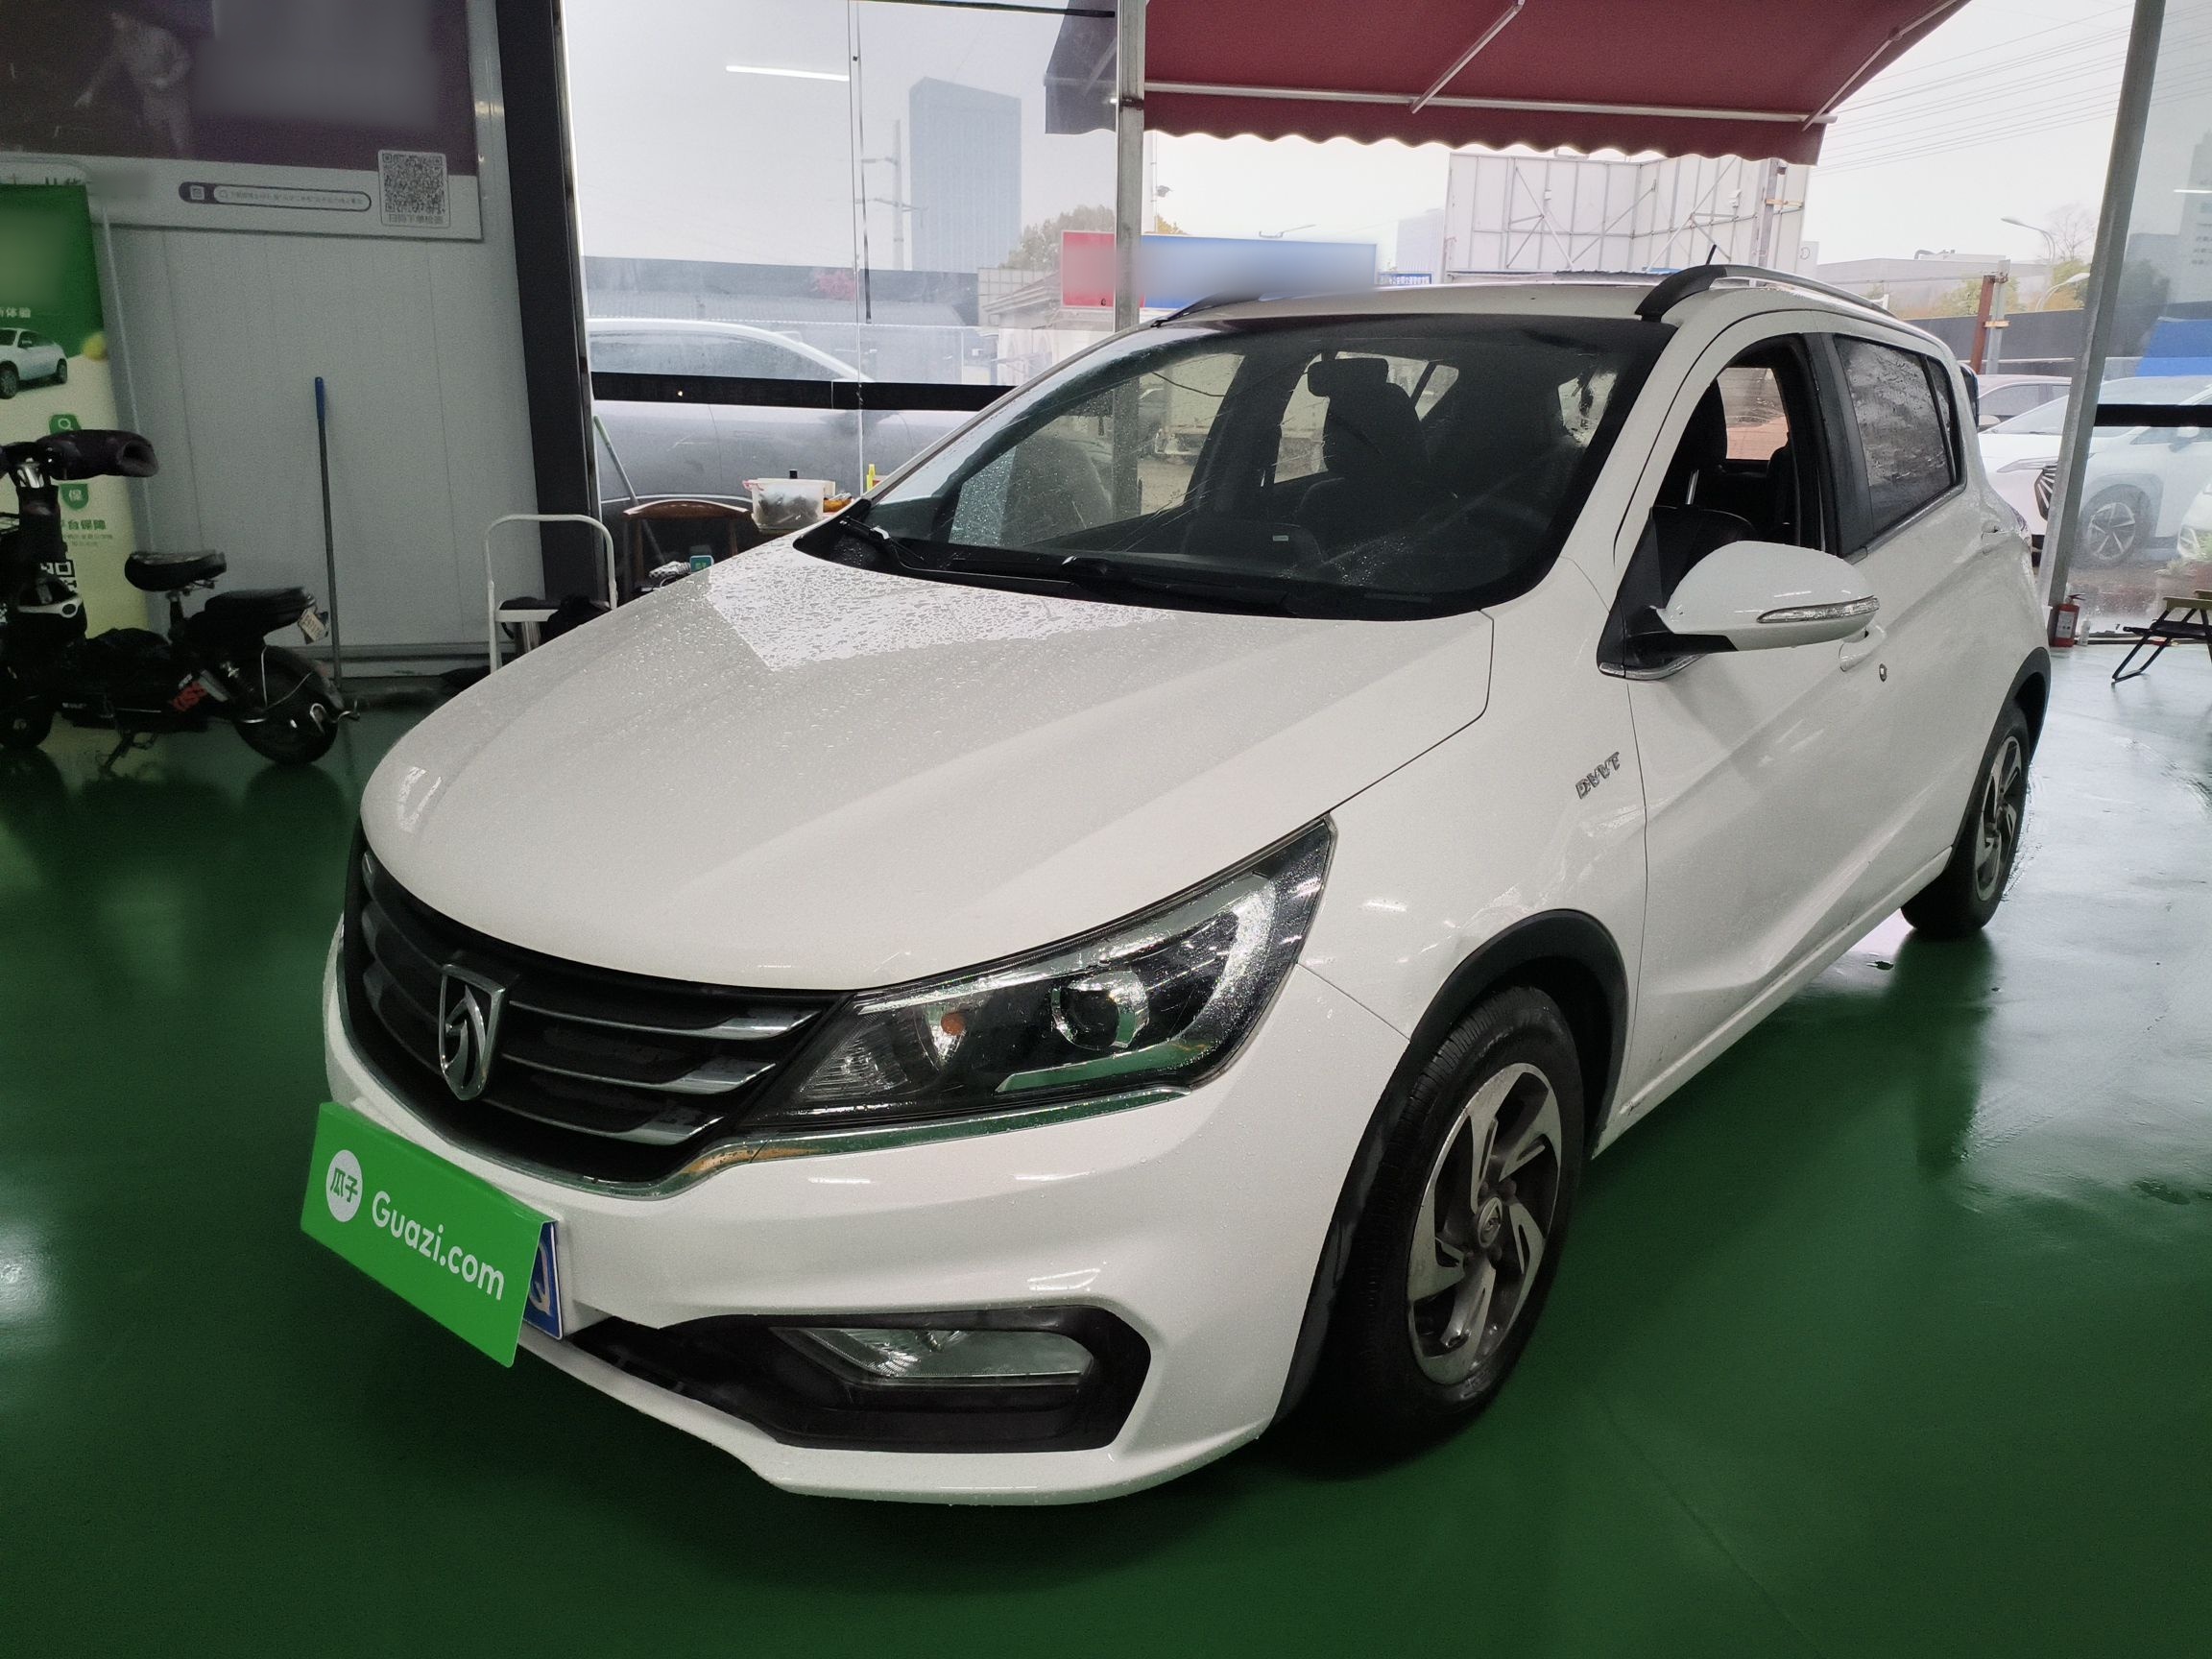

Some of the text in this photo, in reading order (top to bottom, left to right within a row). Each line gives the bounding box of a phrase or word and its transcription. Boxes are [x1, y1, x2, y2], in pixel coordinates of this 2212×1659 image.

[1575, 751, 1621, 800] DVVT
[330, 1167, 359, 1204] 瓜子
[372, 1190, 505, 1301] Guazi.com
